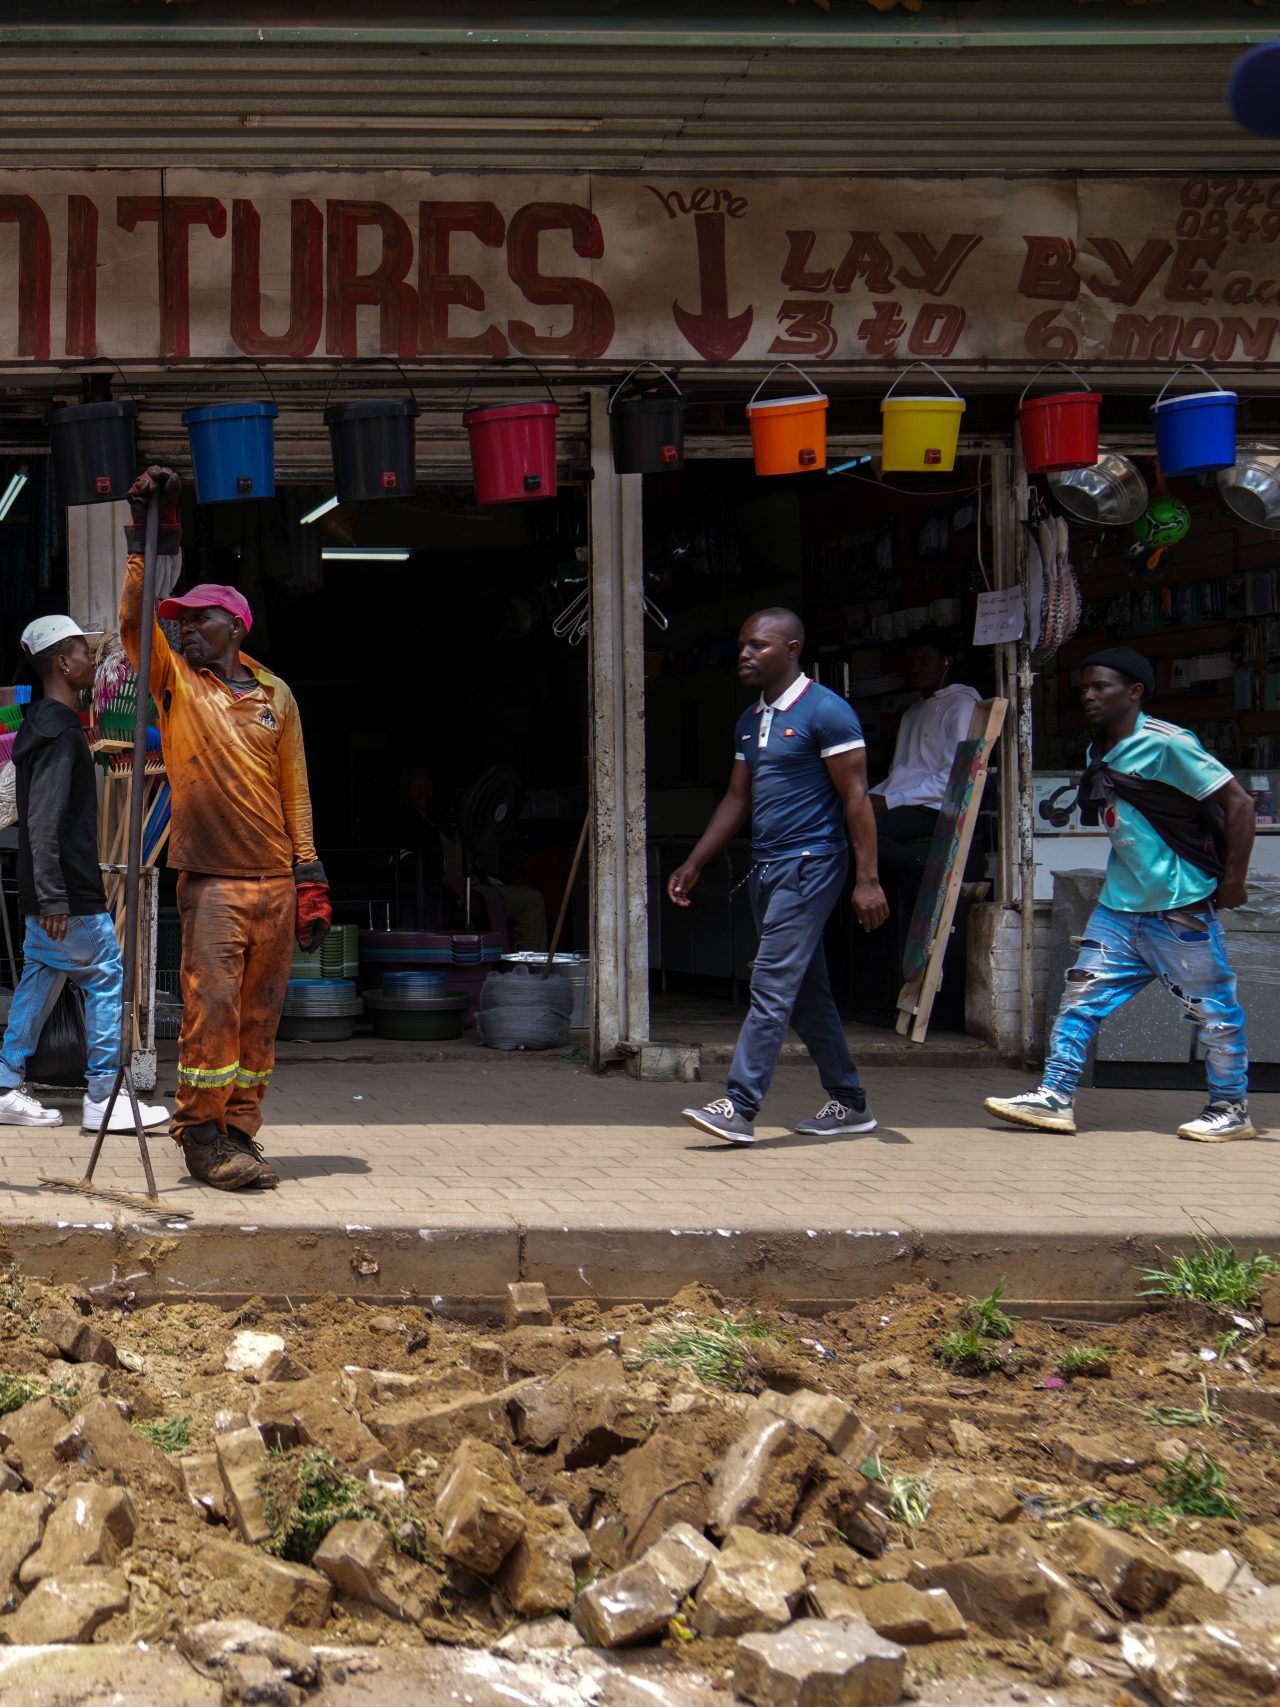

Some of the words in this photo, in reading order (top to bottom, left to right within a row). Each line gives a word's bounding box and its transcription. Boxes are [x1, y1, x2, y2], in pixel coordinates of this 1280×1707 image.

[644, 185, 748, 218] here
[780, 230, 983, 296] LAY
[1019, 235, 1228, 306] BYE
[1222, 277, 1280, 306] ac
[767, 300, 838, 360] 3
[1023, 308, 1081, 360] 6
[1108, 313, 1280, 362] MON
